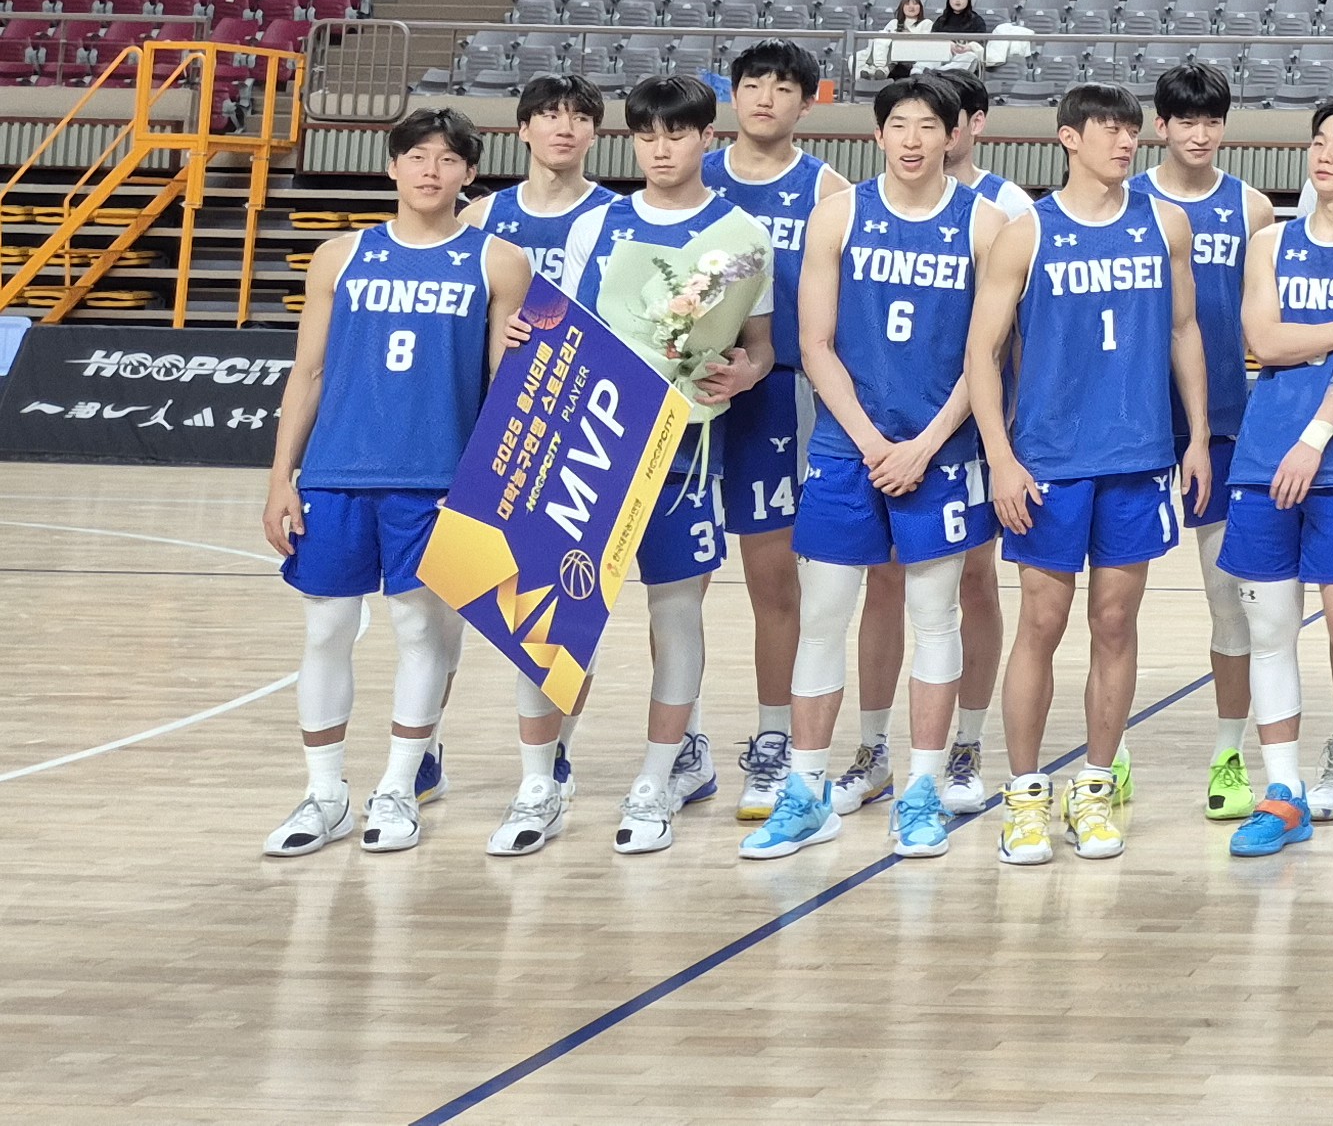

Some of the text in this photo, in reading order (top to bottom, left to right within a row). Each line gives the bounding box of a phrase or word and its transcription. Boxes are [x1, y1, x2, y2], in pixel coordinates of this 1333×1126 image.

[850, 249, 969, 291] YONSEI
[1044, 256, 1163, 296] YONSEI
[346, 278, 476, 317] YONSEI
[886, 301, 914, 342] 6
[1100, 309, 1117, 351] 1
[386, 331, 417, 371] 8
[541, 325, 584, 415] 스토브리그
[561, 365, 590, 423] PLAYER
[545, 378, 626, 543] MVP
[753, 476, 796, 521] 14
[690, 522, 716, 563] 3
[943, 501, 966, 543] 6
[1158, 505, 1172, 544] 1
